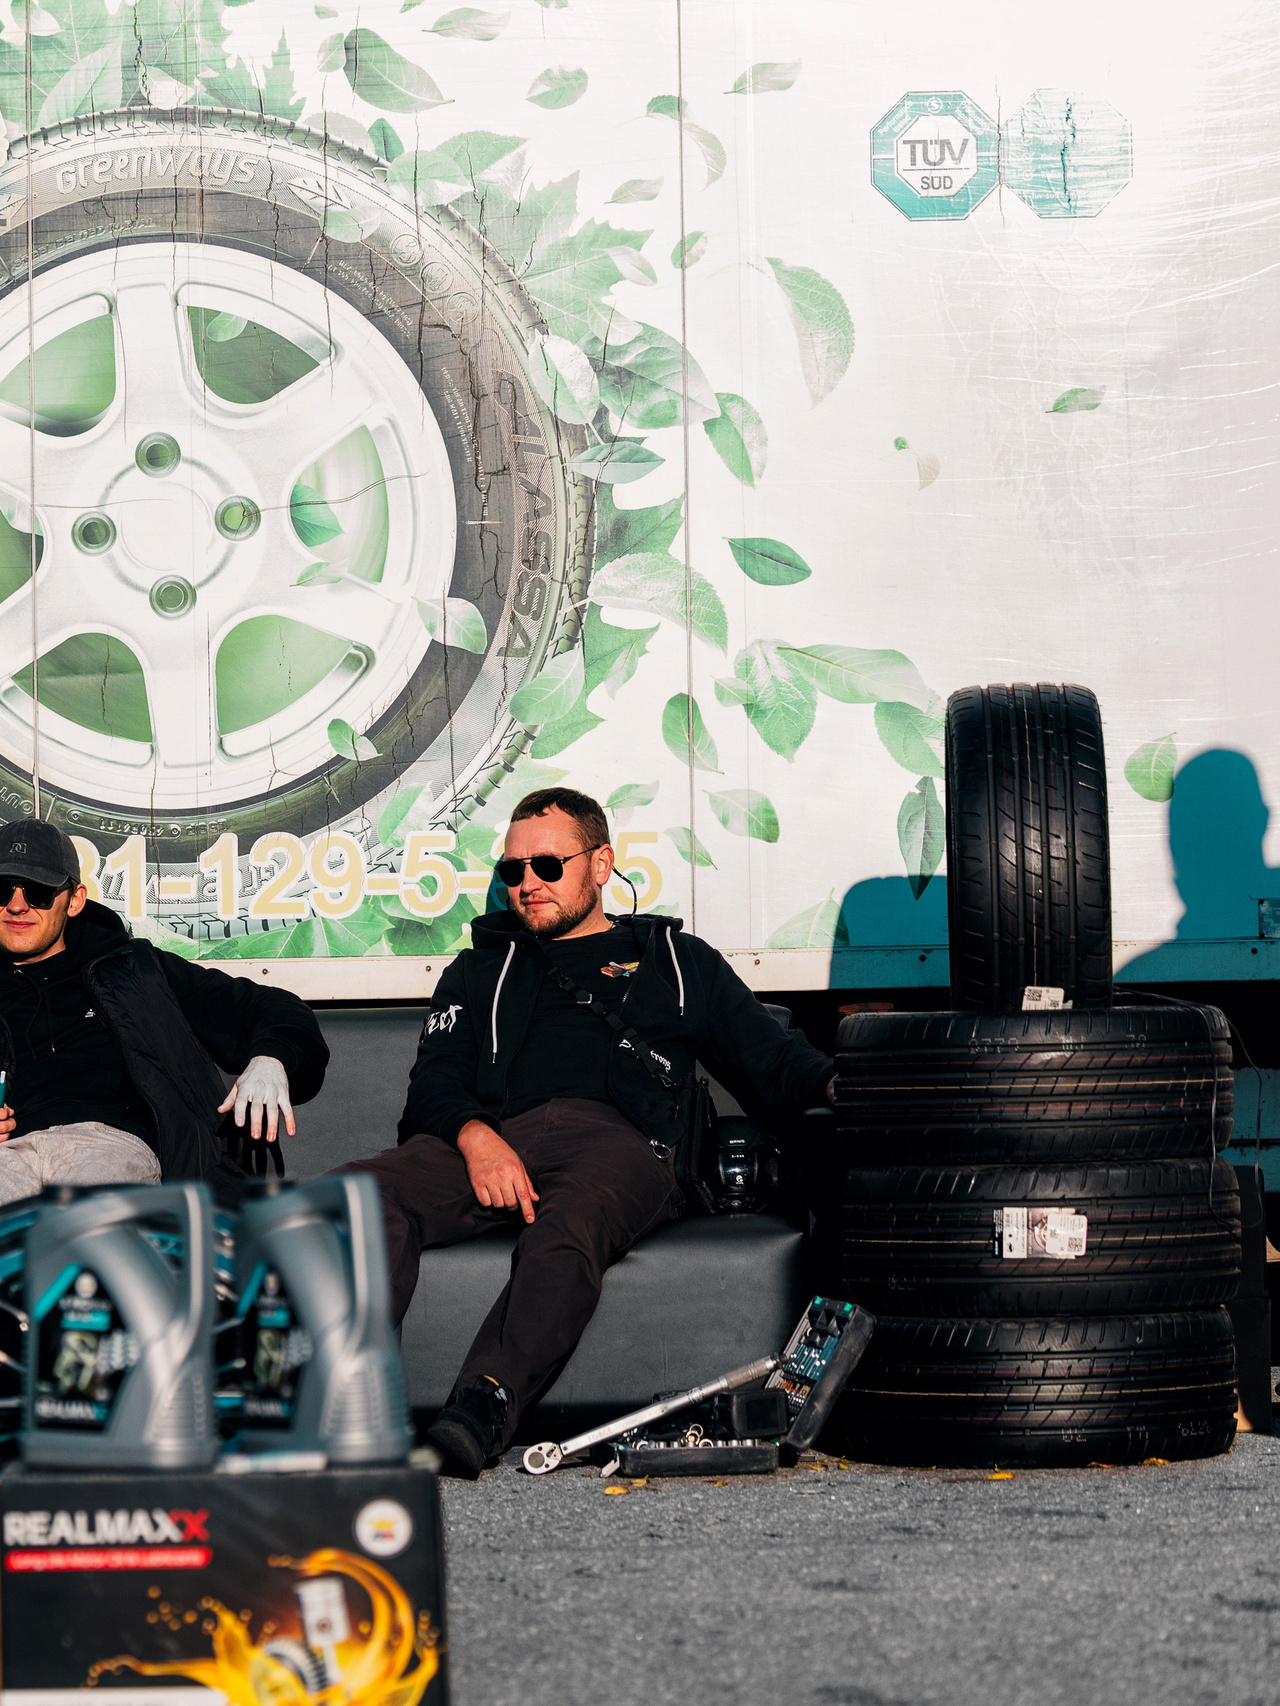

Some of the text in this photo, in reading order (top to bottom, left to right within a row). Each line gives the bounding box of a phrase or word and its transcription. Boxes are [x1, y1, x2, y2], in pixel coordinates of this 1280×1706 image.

[902, 138, 970, 167] TÜV
[56, 147, 261, 195] Greenways
[920, 175, 954, 191] SÜD
